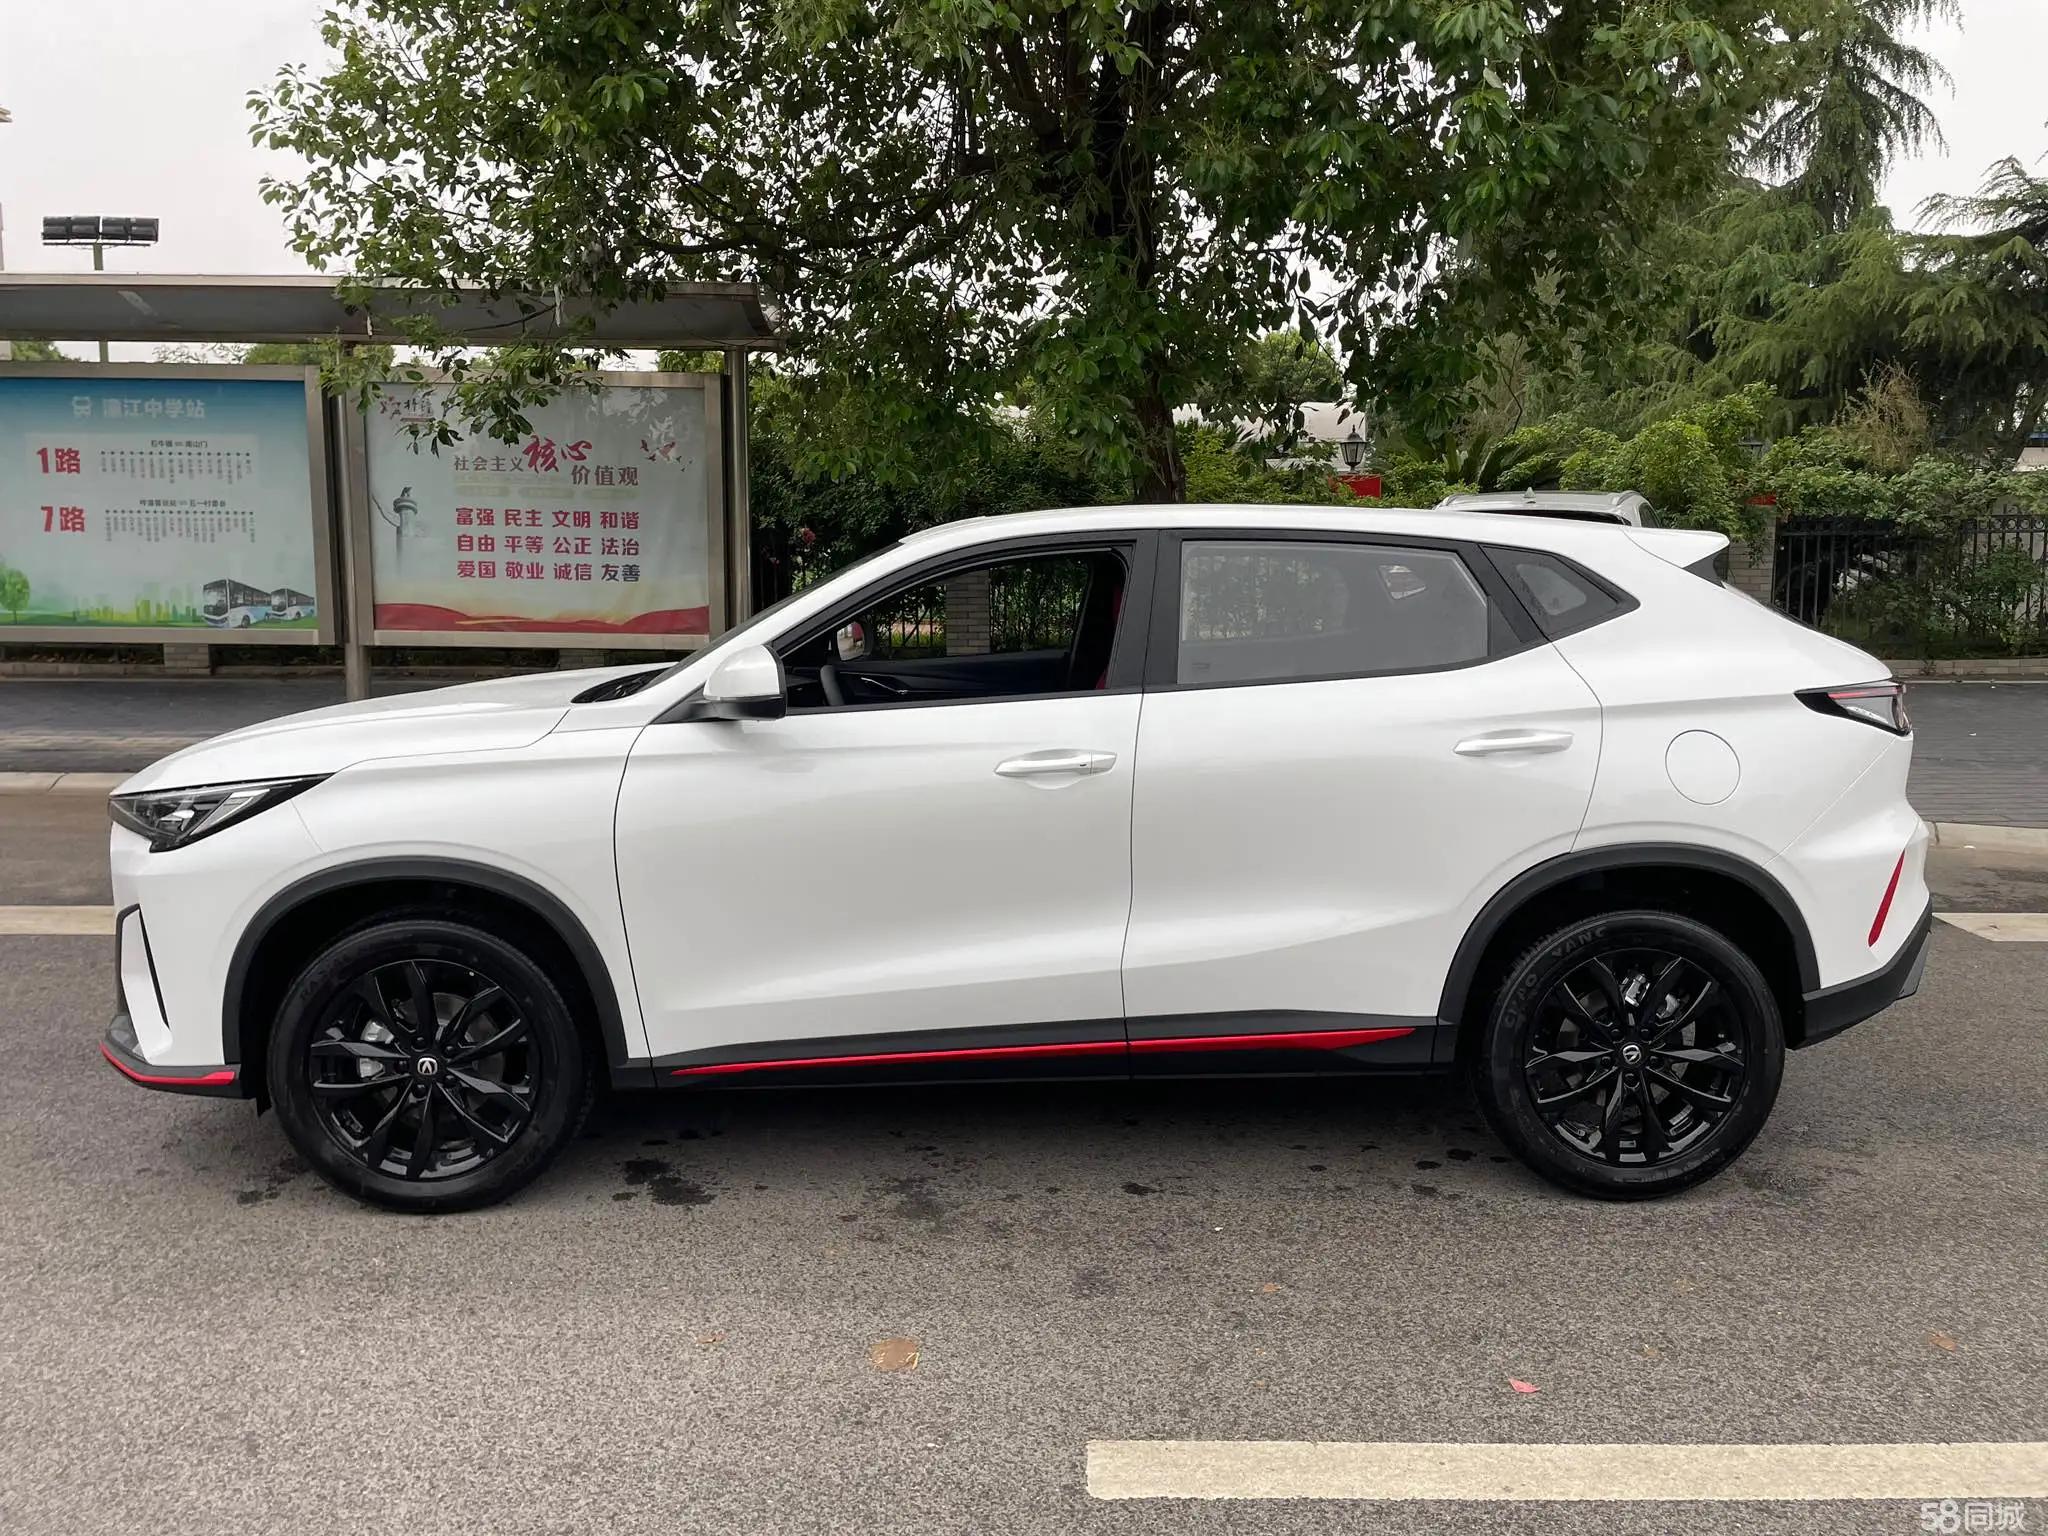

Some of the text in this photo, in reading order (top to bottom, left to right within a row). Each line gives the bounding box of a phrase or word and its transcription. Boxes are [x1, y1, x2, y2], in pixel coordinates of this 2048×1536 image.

[36, 447, 81, 474] 1路
[454, 455, 524, 472] 社会主义
[523, 435, 593, 474] 核心
[571, 465, 639, 486] 价值观
[40, 506, 86, 533] 7路
[455, 507, 640, 530] 富强 民主 文明 和谐
[457, 534, 640, 556] 自由 平等 公正 法治
[457, 560, 640, 582] 爱国 敬业 诚信 友善
